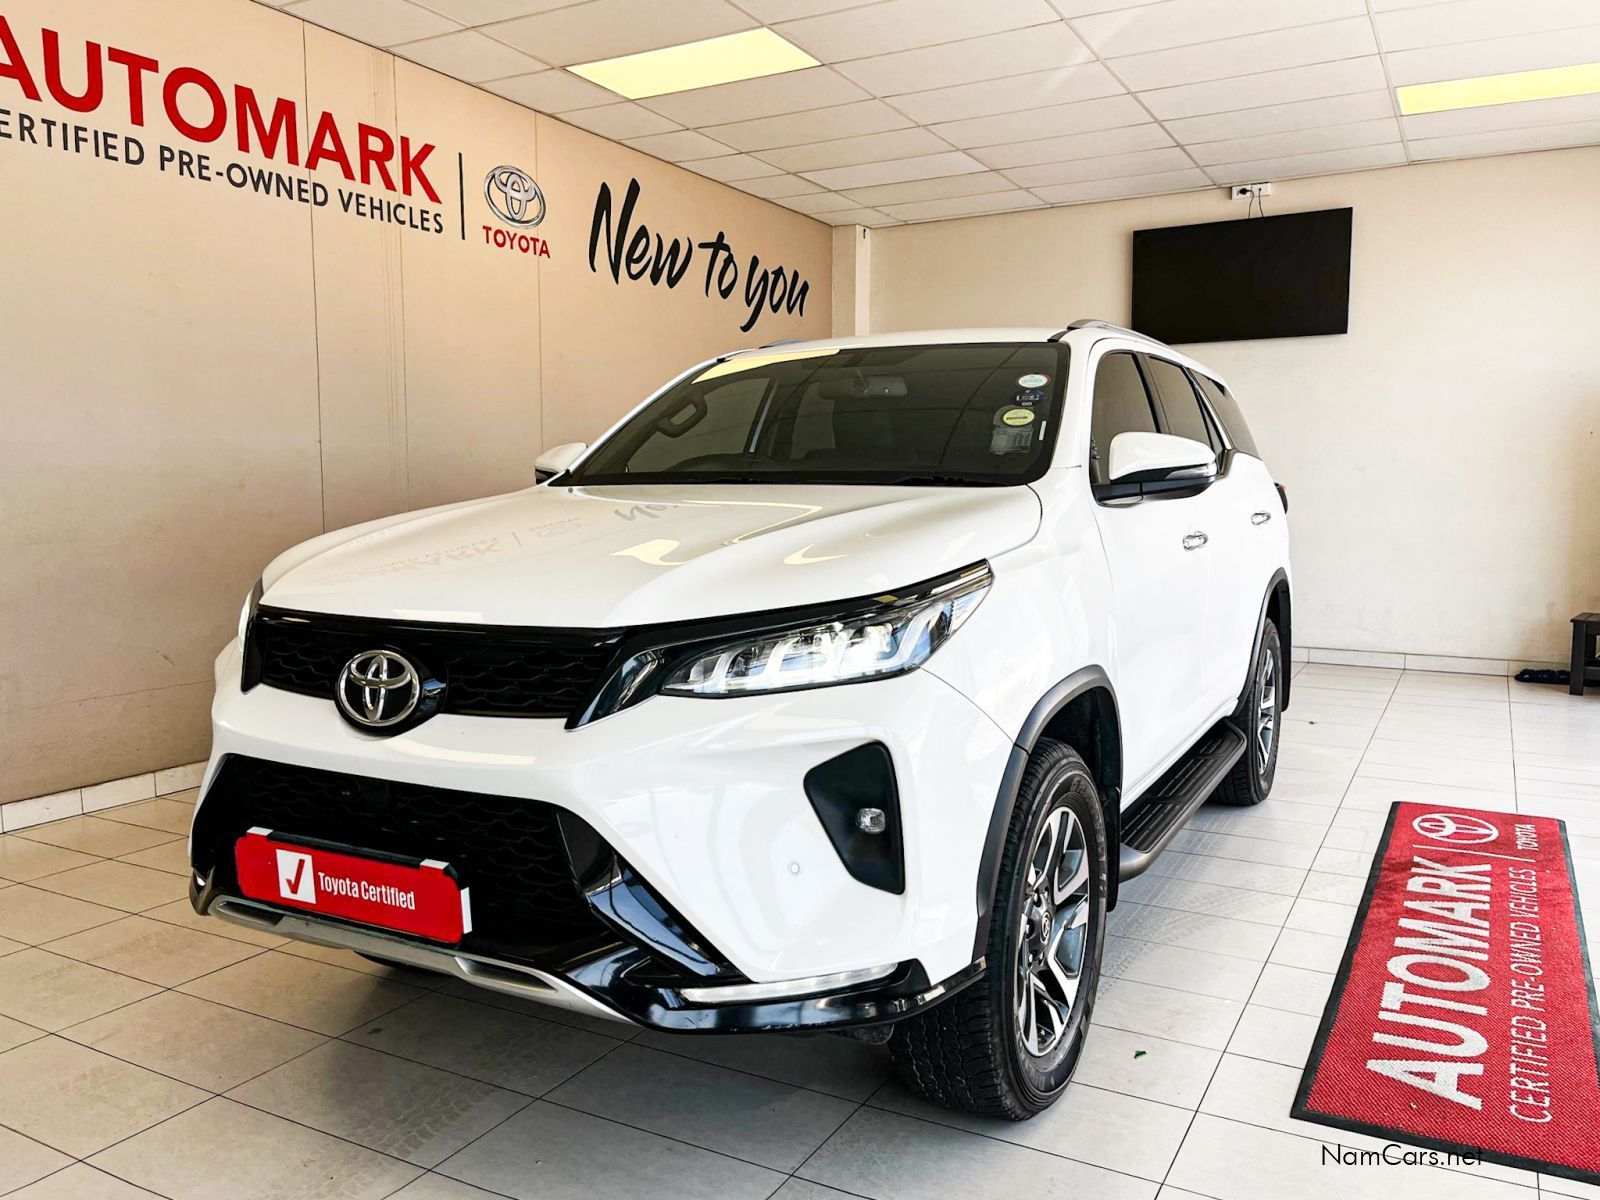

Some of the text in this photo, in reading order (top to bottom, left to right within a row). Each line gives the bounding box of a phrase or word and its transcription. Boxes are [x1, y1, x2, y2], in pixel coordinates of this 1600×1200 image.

[0, 109, 443, 234] ERTIFIED PRE-OWNED VEHICLES
[482, 226, 550, 258] TOYOTA
[589, 178, 809, 332] New to you
[318, 871, 415, 910] Toyota Certified
[1515, 823, 1539, 851] TOYOTA
[1366, 855, 1492, 1111] AUTOMARK
[1508, 867, 1552, 1123] CERTIFIED PRE-OWNED VEHICLES
